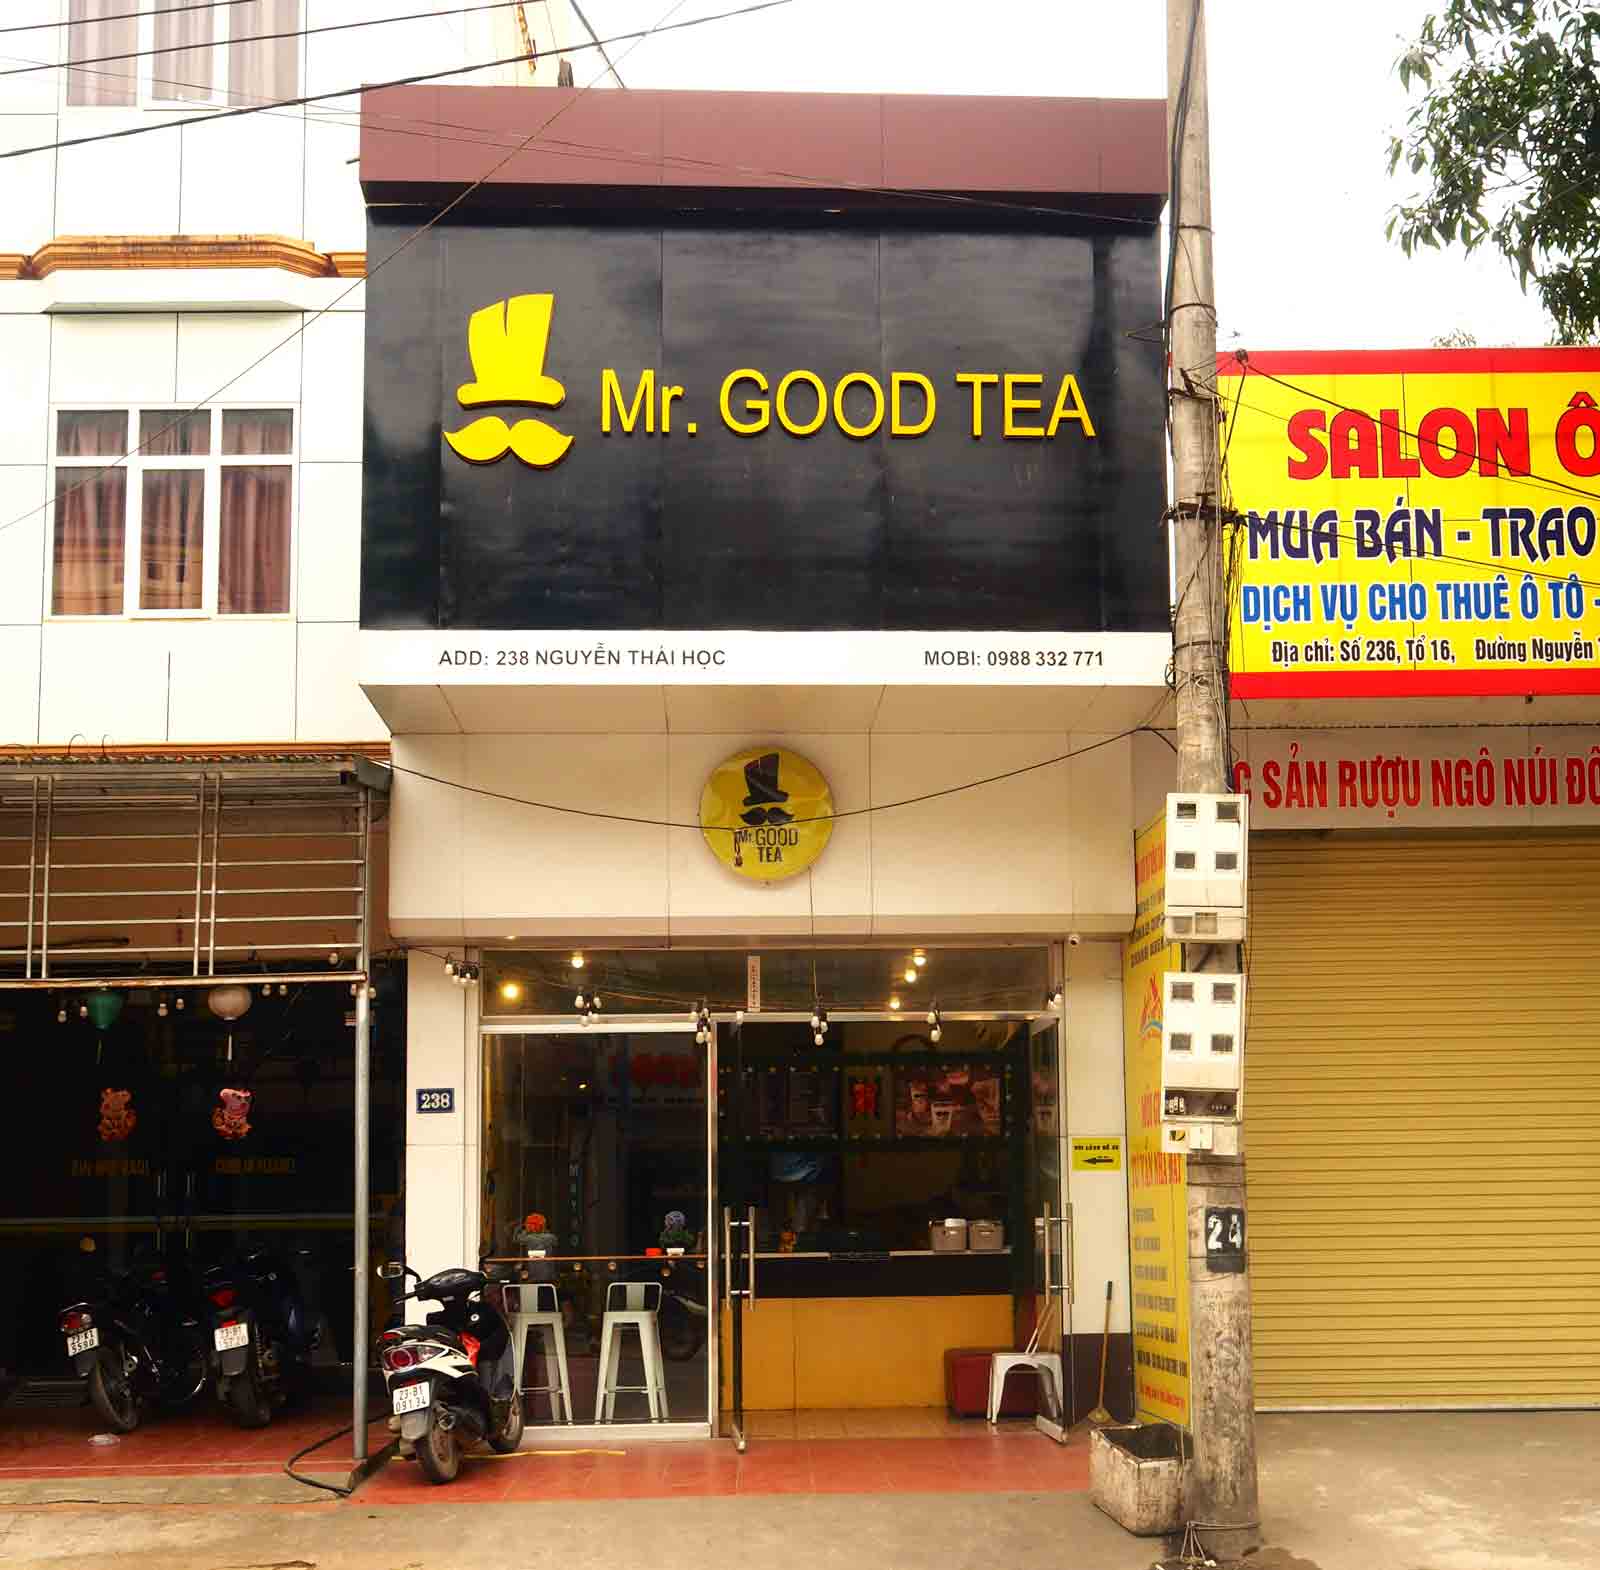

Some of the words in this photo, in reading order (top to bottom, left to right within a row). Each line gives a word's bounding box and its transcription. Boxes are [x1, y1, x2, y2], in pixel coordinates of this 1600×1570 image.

[600, 368, 697, 436] Mr.
[718, 368, 938, 439] GOOD
[955, 373, 1097, 439] TEA
[1287, 407, 1531, 480] SALON
[1555, 391, 1600, 478] Ô
[1247, 509, 1339, 564] MUA
[1354, 496, 1443, 564] BÁN
[1482, 506, 1597, 563] TRAO
[1242, 584, 1311, 631] DỊCH
[1321, 583, 1358, 630] VỤ
[1368, 583, 1427, 621] CHO
[1436, 574, 1510, 620] THUÊ
[1520, 574, 1539, 620] Ô
[1548, 573, 1584, 620] TÔ
[439, 649, 489, 666] ADD:
[496, 650, 530, 666] 238
[535, 642, 621, 666] NGUYỄN
[628, 644, 675, 666] THÁI
[682, 649, 726, 670] HỌC
[924, 650, 981, 667] MOBI:
[987, 650, 1031, 667] 0988
[1035, 650, 1068, 667] 332
[1073, 650, 1104, 667] 771
[1272, 641, 1299, 667] Địa
[1304, 636, 1335, 663] chỉ:
[1340, 636, 1362, 662] Số
[1366, 640, 1401, 664] 236,
[1406, 634, 1426, 661] Tổ
[1431, 639, 1456, 663] 16,
[1475, 635, 1526, 663] Đường
[1532, 631, 1593, 663] Nguyễn
[1262, 743, 1328, 809] SẢN
[1338, 755, 1422, 818] RƯỢU
[1431, 747, 1495, 808] NGÔ
[1504, 746, 1559, 806] NÚI
[755, 827, 798, 847] GOOD
[758, 846, 783, 863] TEA
[420, 1093, 450, 1109] 238
[1207, 1214, 1242, 1250] 24
